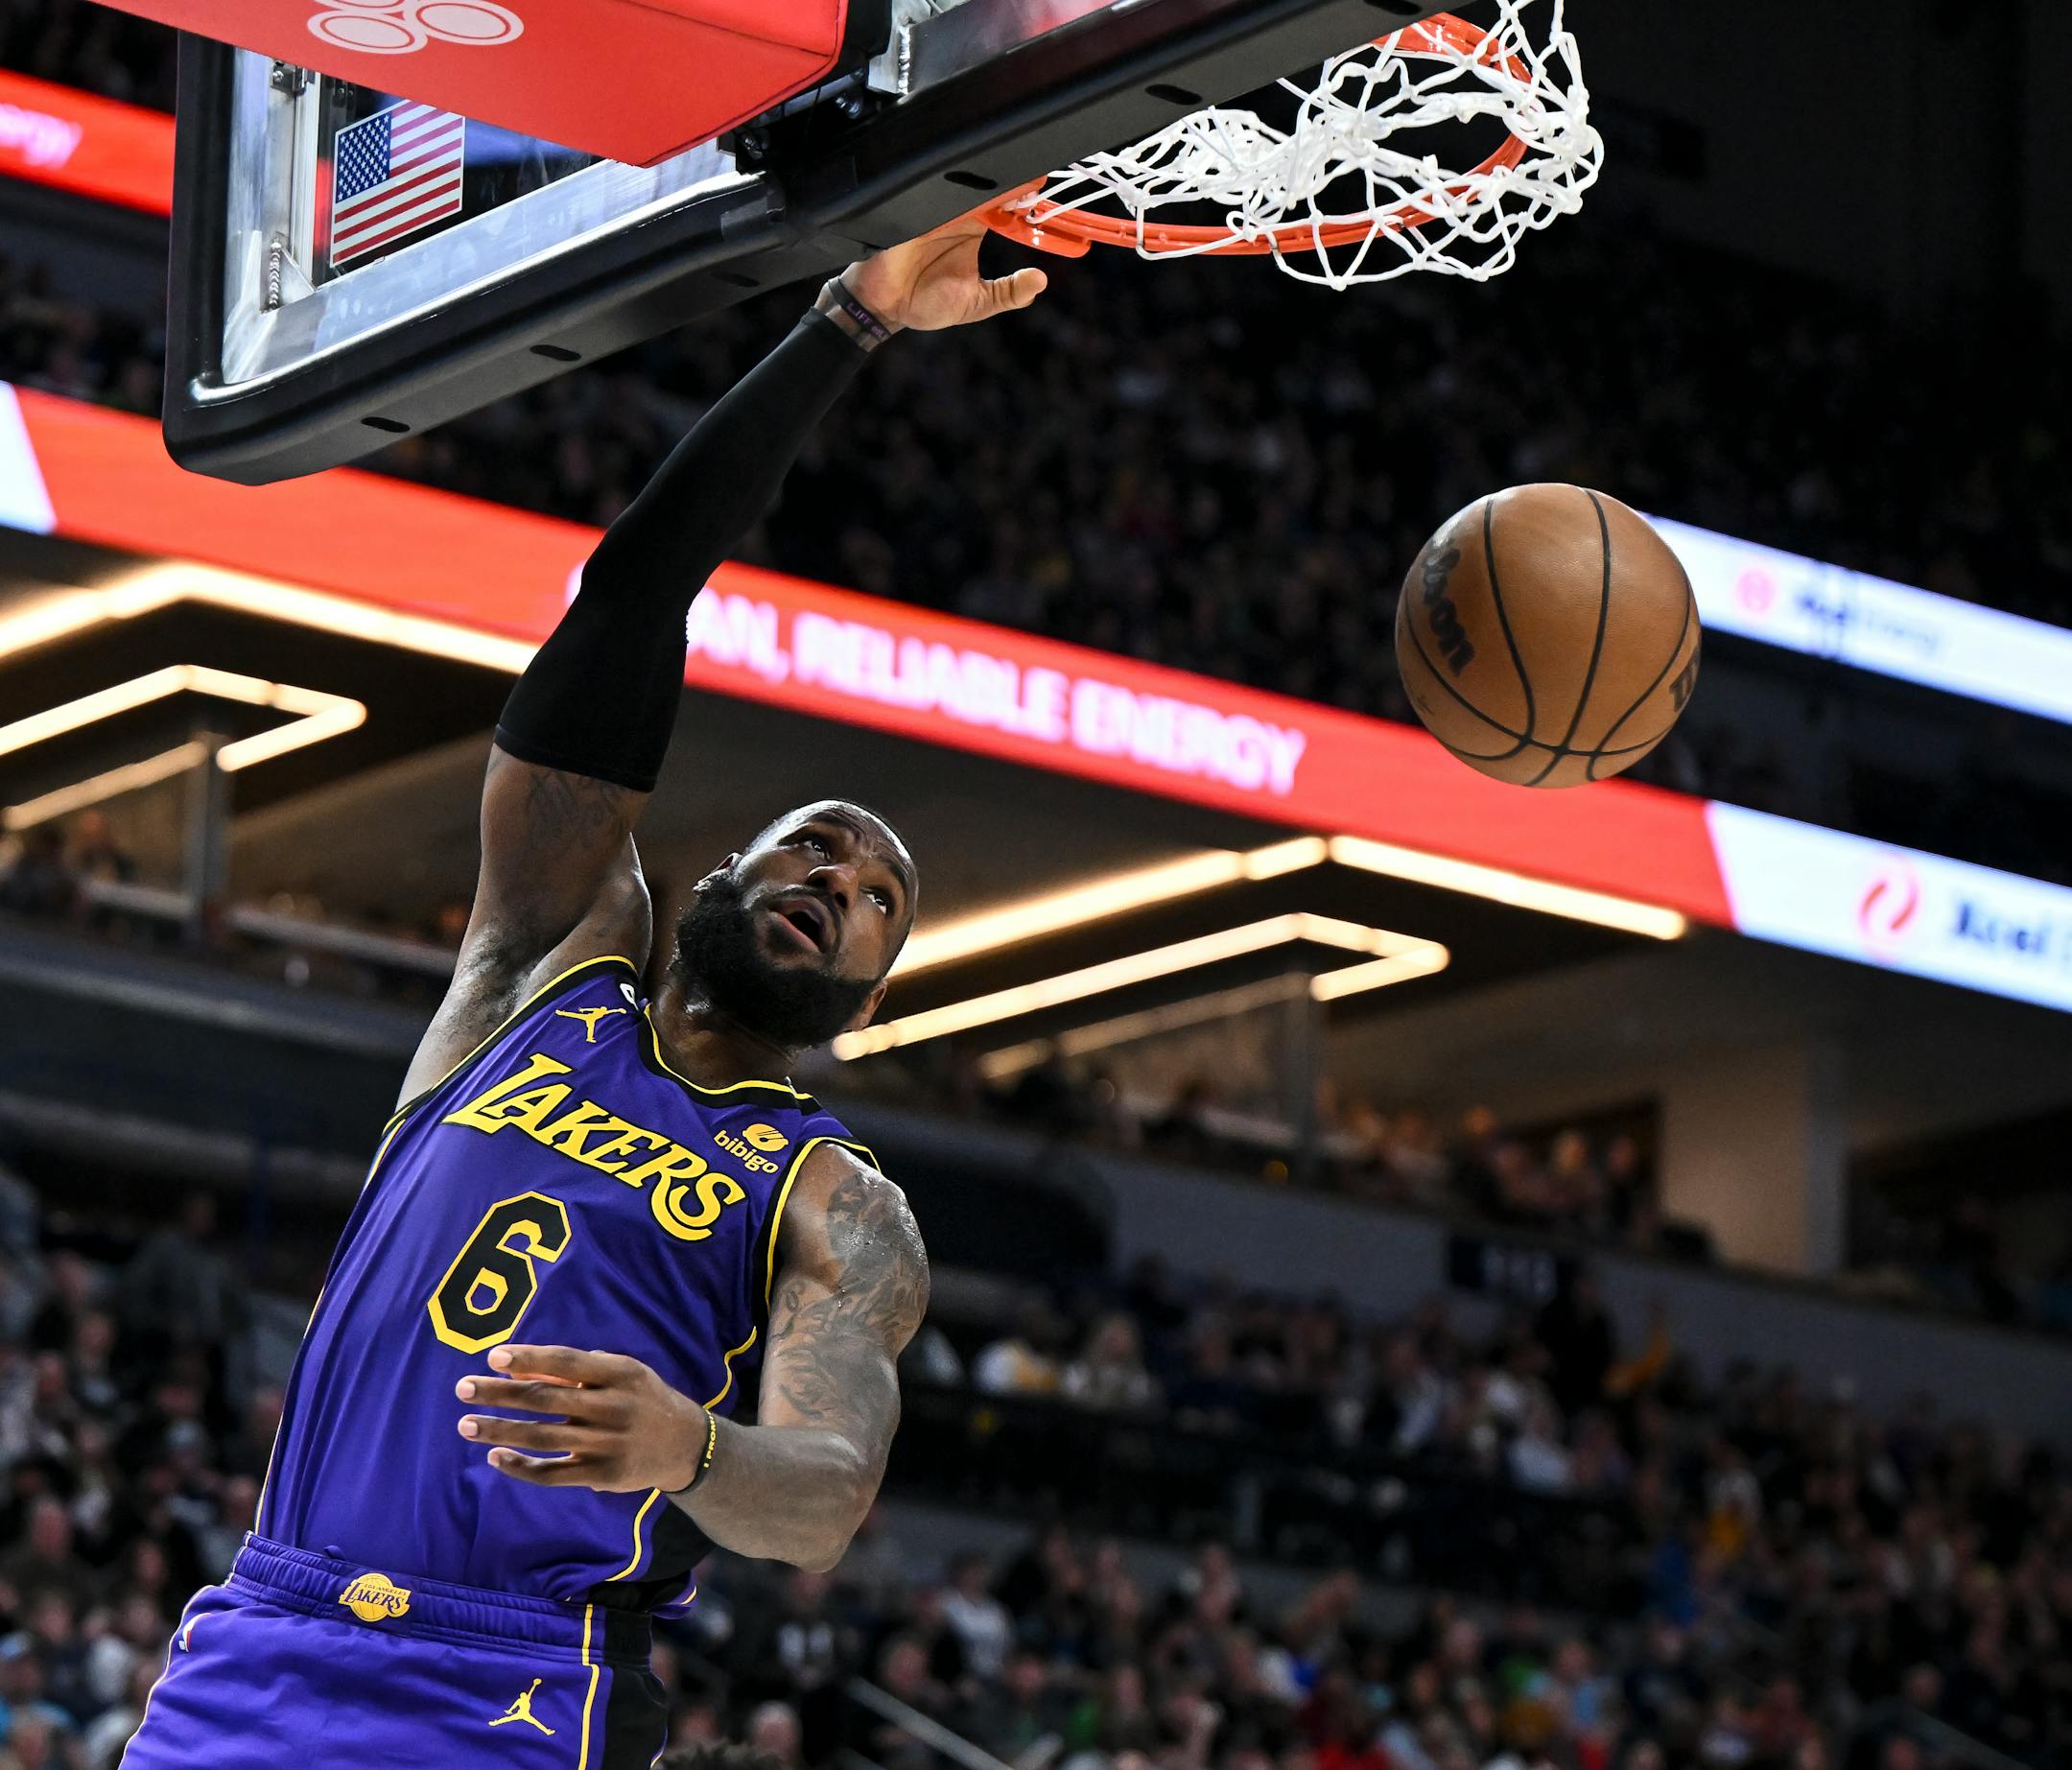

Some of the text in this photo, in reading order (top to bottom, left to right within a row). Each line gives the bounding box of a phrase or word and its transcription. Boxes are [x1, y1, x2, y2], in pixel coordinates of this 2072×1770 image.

[793, 612, 1071, 743] RELIABLE
[1072, 677, 1307, 796] ENERGY
[442, 1051, 747, 1241] LAKERS
[713, 1130, 779, 1173] bibigo
[427, 1191, 572, 1355] 6
[343, 1582, 407, 1615] LAKERS
